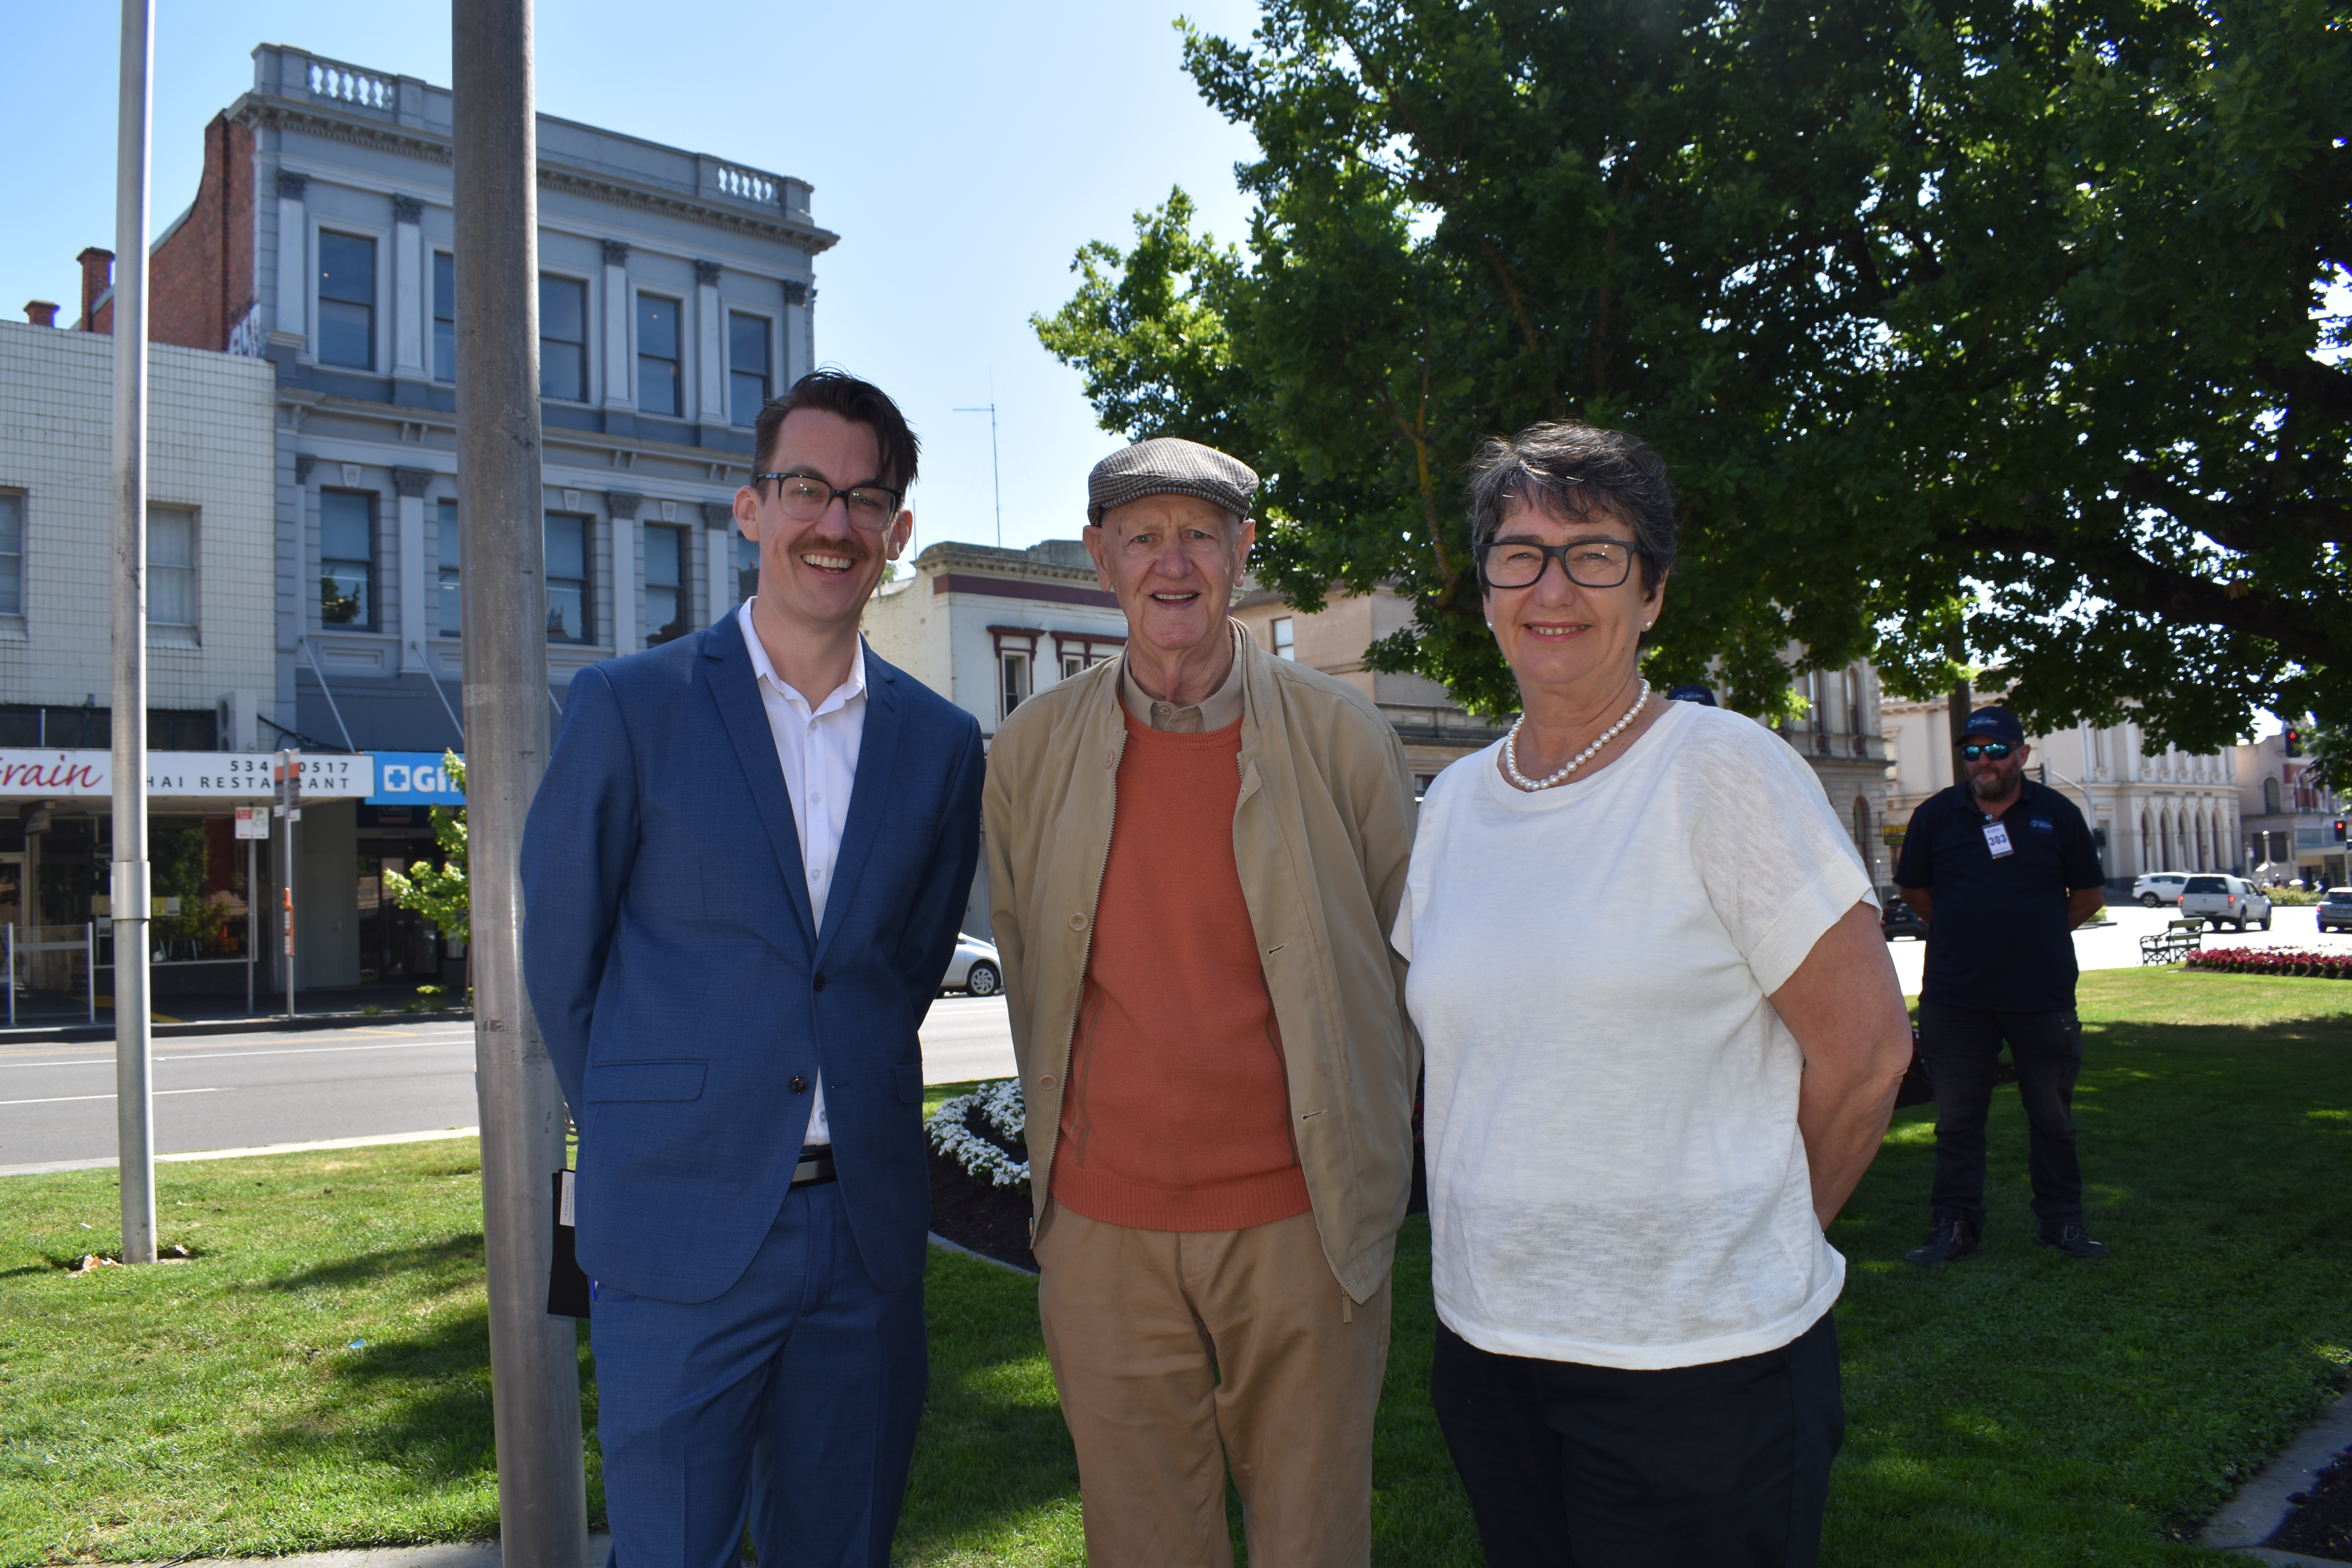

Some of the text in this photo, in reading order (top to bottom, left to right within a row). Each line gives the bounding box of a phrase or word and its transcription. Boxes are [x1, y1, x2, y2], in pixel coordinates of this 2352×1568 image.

[0, 755, 103, 787] rain
[230, 760, 348, 773] 534 0517
[147, 776, 348, 789] HAI RESTAANT
[1989, 834, 2007, 846] 303
